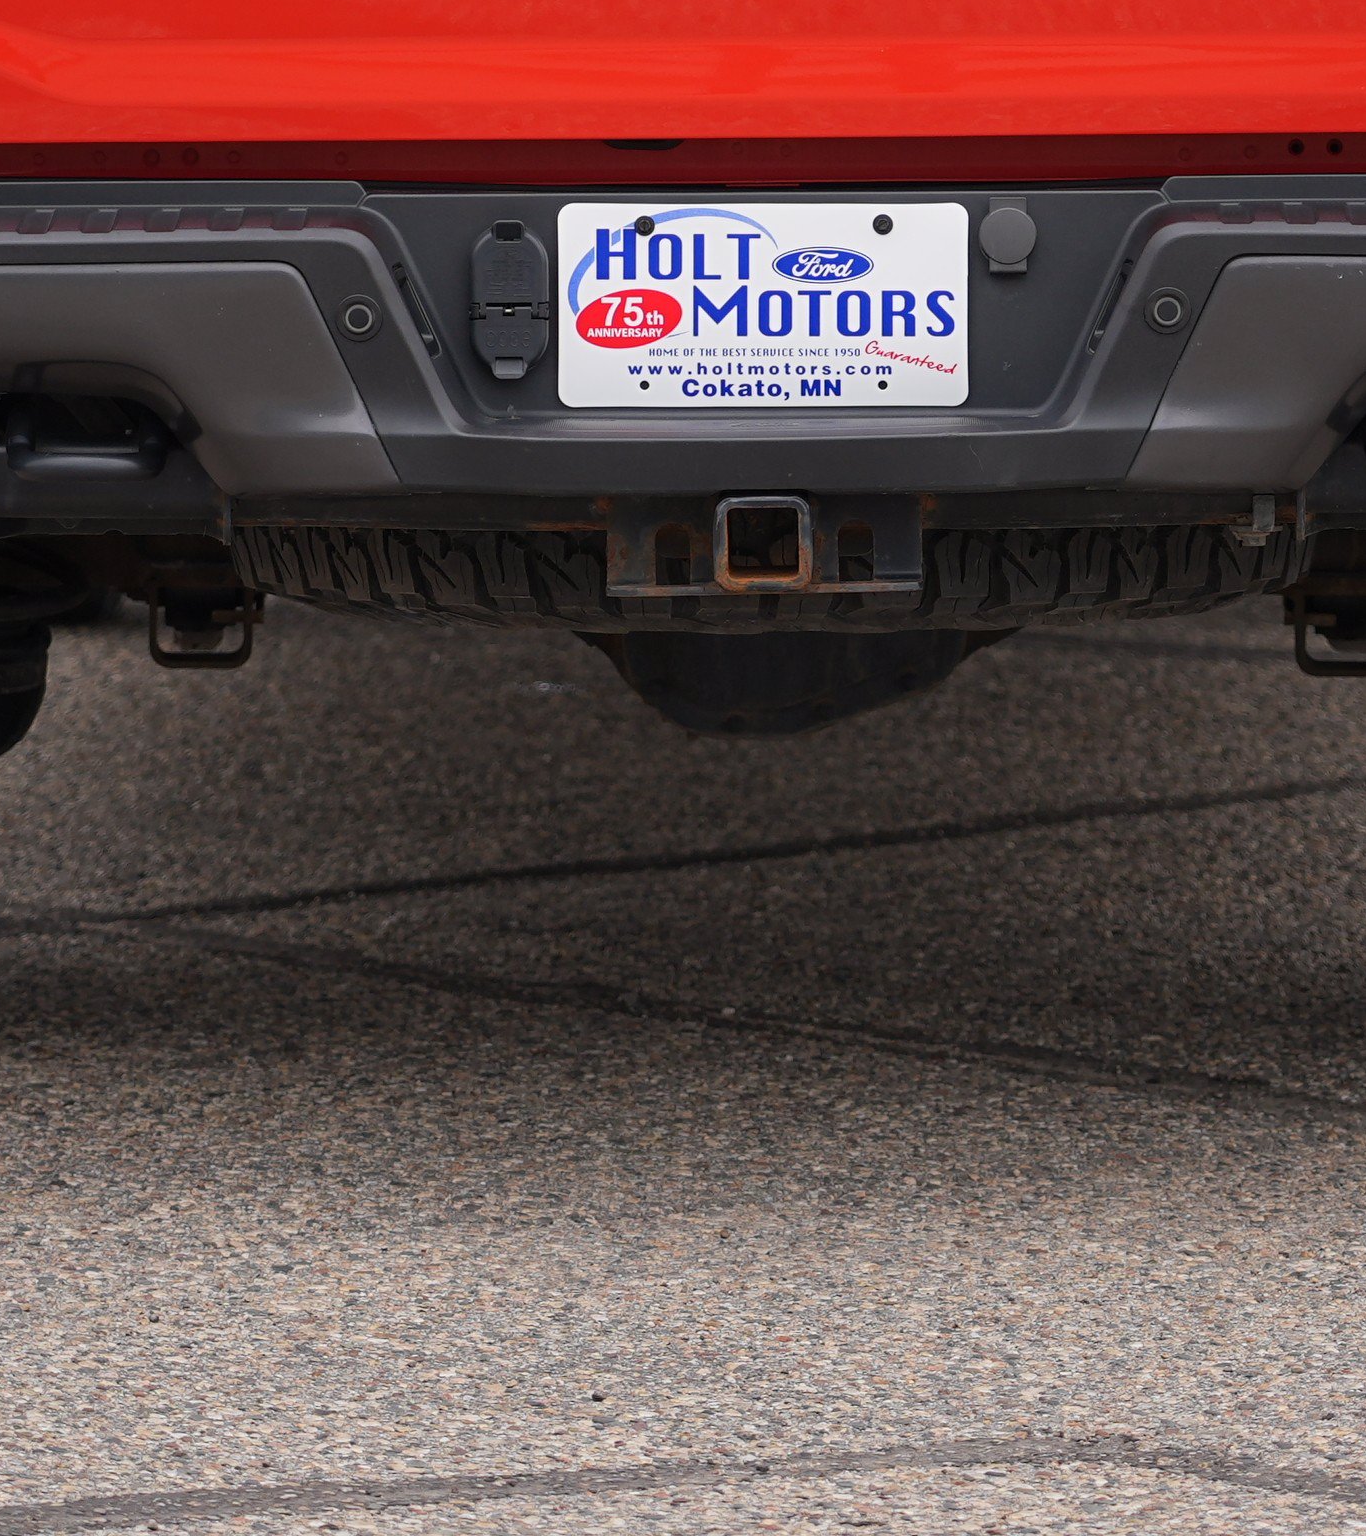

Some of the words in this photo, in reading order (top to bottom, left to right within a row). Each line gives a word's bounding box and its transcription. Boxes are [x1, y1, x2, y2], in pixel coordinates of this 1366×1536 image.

[596, 228, 761, 280] HOLT
[792, 252, 854, 278] Ford
[601, 296, 664, 327] 75th
[693, 285, 955, 337] MOTORS
[586, 327, 663, 338] ANNIVERSARY
[648, 348, 679, 357] HOME
[683, 348, 695, 357] OF
[699, 348, 717, 357] THE
[722, 348, 746, 357] BEST
[750, 348, 794, 357] SERVICE
[798, 348, 829, 357] SINCE
[834, 348, 861, 357] 1950
[865, 340, 957, 375] Guaranteed
[628, 362, 892, 375] www.holtmotors.com
[682, 379, 790, 400] Cokato,
[800, 379, 841, 396] MN
